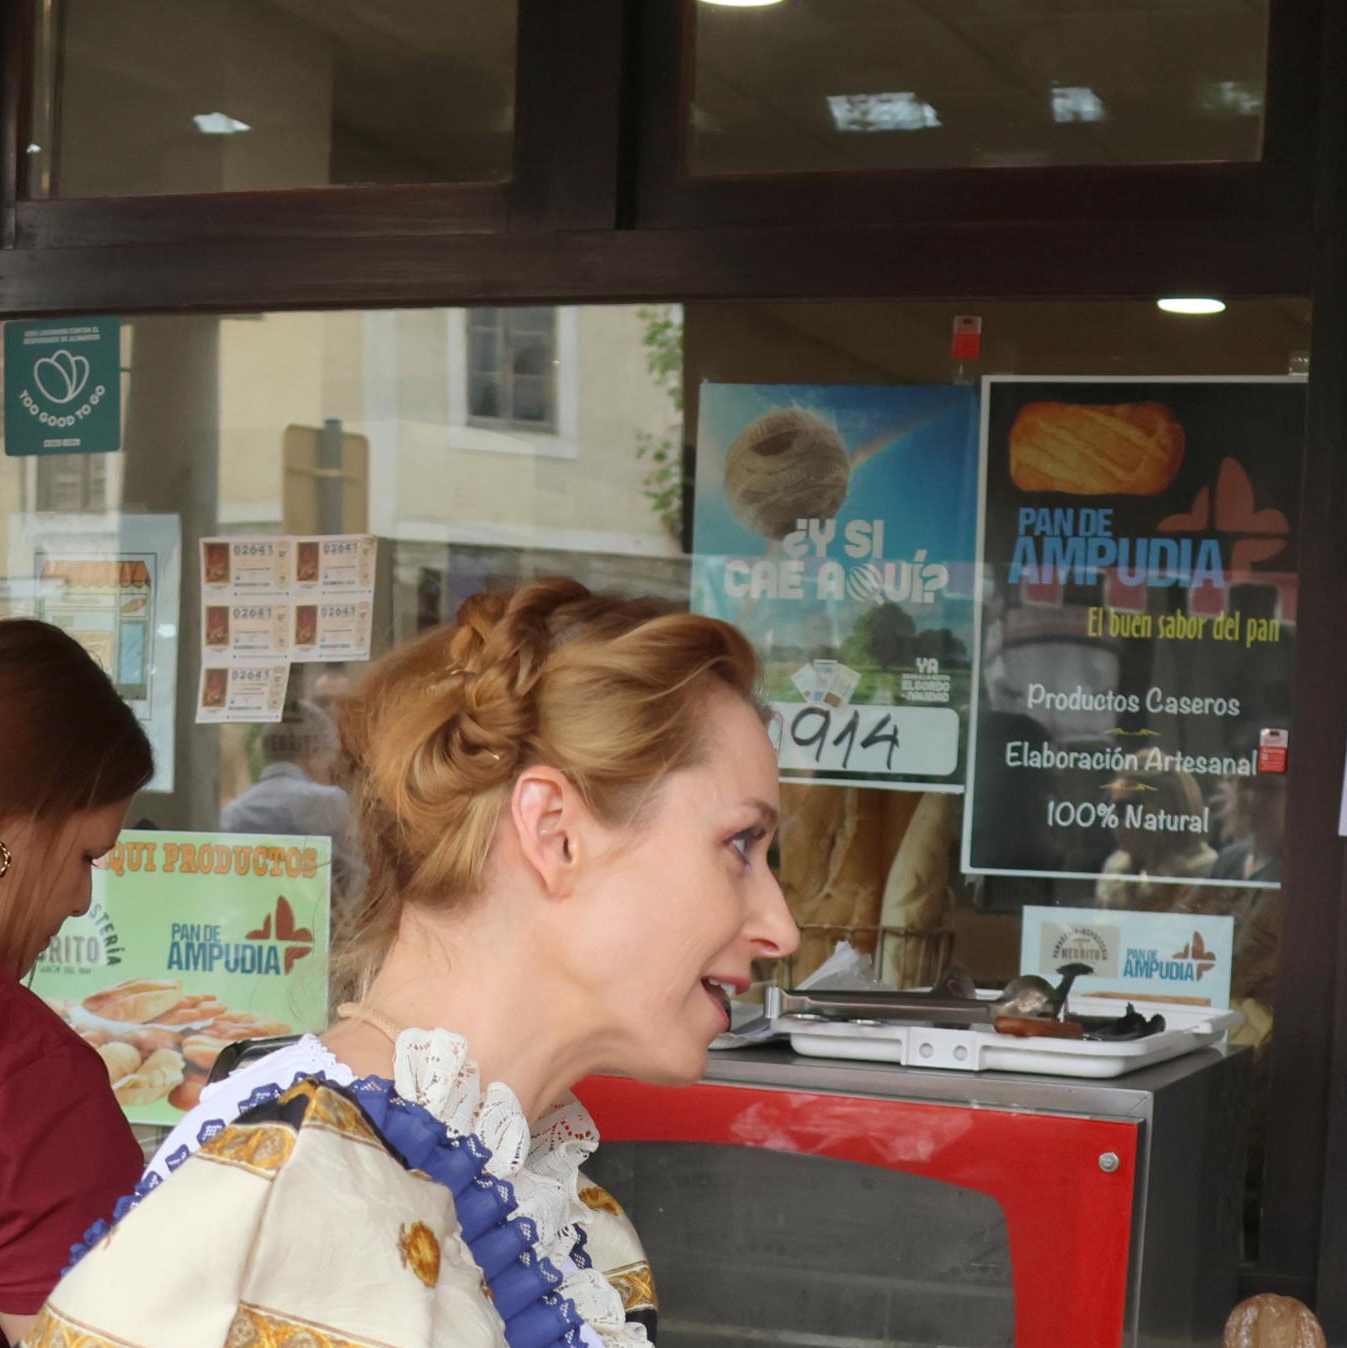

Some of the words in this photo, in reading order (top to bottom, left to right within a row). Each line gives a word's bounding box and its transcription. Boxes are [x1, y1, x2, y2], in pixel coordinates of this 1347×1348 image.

[19, 389, 40, 415] TOO
[39, 411, 75, 428] GOOD
[76, 403, 92, 420] TO
[89, 384, 106, 405] GO
[1018, 507, 1074, 536] PAN
[1079, 508, 1114, 537] DE
[233, 544, 273, 556] 02641
[323, 542, 358, 555] 02641
[782, 518, 836, 558] ¿Y
[844, 519, 884, 559] SI
[724, 559, 805, 600] CAE
[817, 549, 949, 604] AQUÍ?
[1007, 535, 1226, 588] AMPUDIA
[233, 607, 272, 619] 02641
[320, 605, 356, 618] 02641
[1087, 606, 1103, 637] El
[1109, 607, 1152, 638] buen
[1158, 608, 1207, 641] sabor
[1212, 611, 1240, 641] del
[1246, 615, 1280, 648] pan
[231, 669, 269, 681] 02641
[916, 657, 939, 674] YA
[1027, 683, 1139, 713] Productos
[1146, 687, 1240, 716] Caseros
[1005, 741, 1138, 771] Elaboración
[1144, 746, 1257, 776] Artesanal
[1047, 801, 1118, 828] 100%
[1125, 804, 1209, 833] Natural
[101, 841, 157, 876] QUI
[163, 841, 318, 879] PRODUCTOS
[172, 922, 200, 942] PAN
[204, 924, 221, 943] DE
[167, 941, 281, 976] AMPUDIA
[1126, 948, 1145, 960] PAN
[1123, 959, 1195, 982] AMPUDIA
